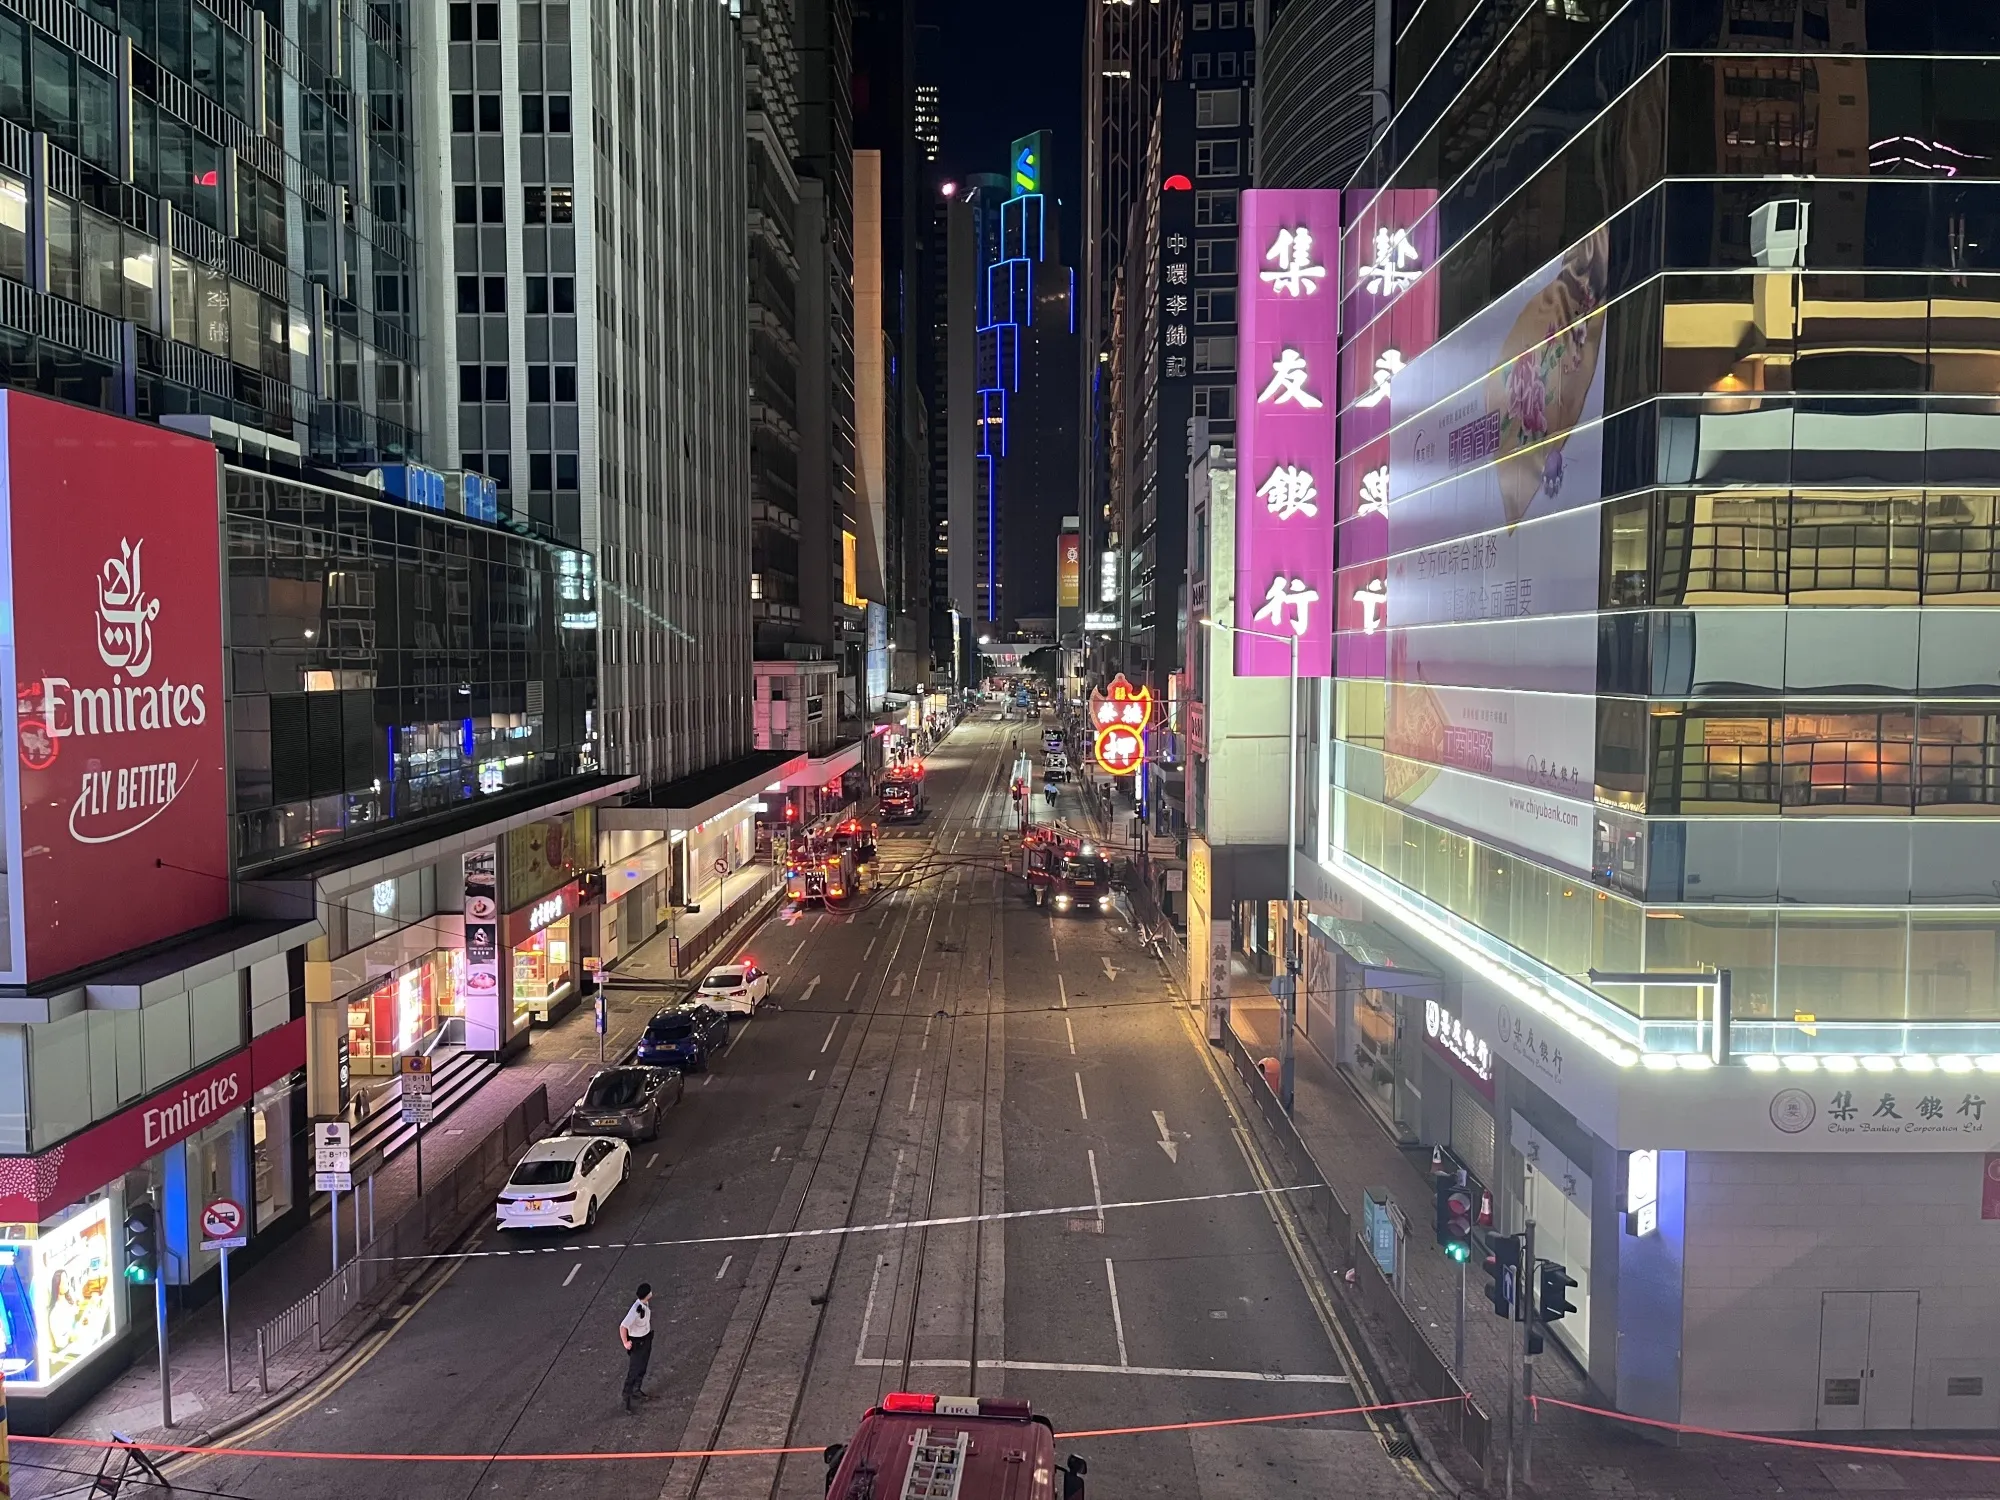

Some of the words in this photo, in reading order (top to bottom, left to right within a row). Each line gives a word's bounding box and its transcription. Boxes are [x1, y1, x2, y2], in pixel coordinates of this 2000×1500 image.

[1165, 232, 1189, 378] 中環李錦記
[1254, 227, 1326, 636] 集友銀行
[1449, 412, 1500, 468] 財富管理
[41, 673, 207, 738] Emirates
[1102, 731, 1137, 766] 押
[1443, 729, 1494, 772] 工商服務
[80, 769, 112, 817] FLY
[116, 762, 178, 811] BETTER
[1509, 796, 1579, 827] www.chiyubank.com
[142, 1072, 239, 1149] Emirates
[1827, 1123, 1856, 1133] Chiyu
[1859, 1123, 1901, 1134] Banking
[1904, 1123, 1958, 1133] Corporation
[1828, 1090, 1987, 1121] 集友銀行
